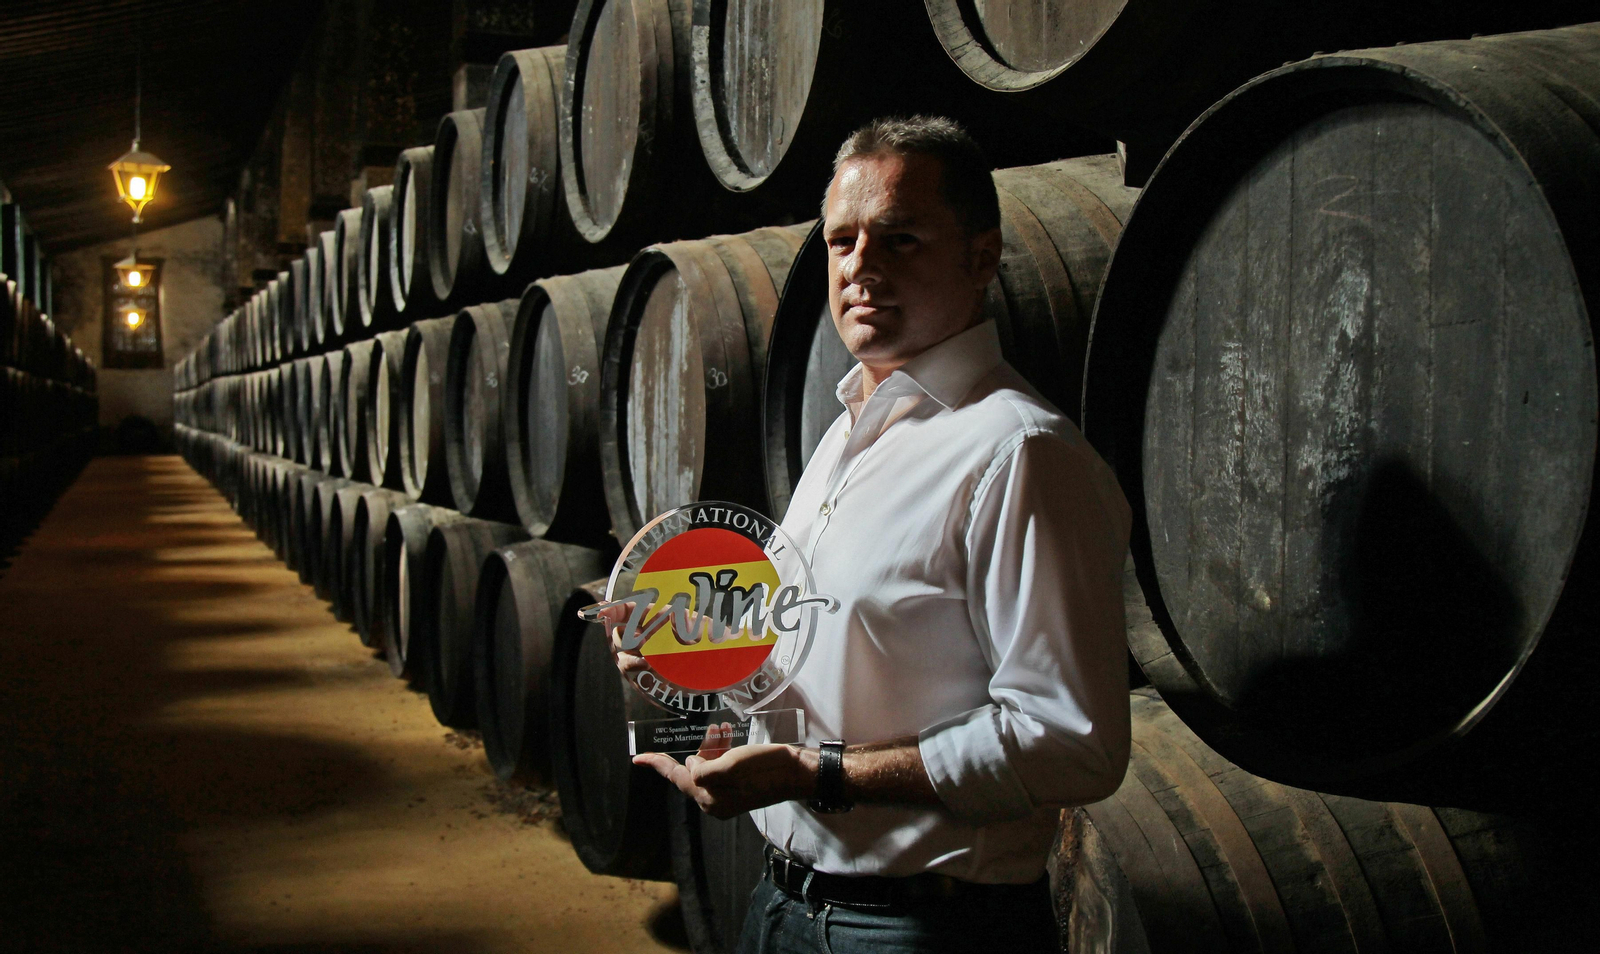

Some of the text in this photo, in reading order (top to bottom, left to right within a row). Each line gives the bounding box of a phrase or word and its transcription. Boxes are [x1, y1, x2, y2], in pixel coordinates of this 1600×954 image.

[706, 367, 729, 390] 30
[621, 507, 787, 573] INTERNATIONAL
[579, 571, 832, 651] Wine
[653, 735, 673, 745] Sergio
[722, 729, 744, 739] Emilio
[655, 727, 669, 735] IWC
[669, 725, 689, 735] Spanish
